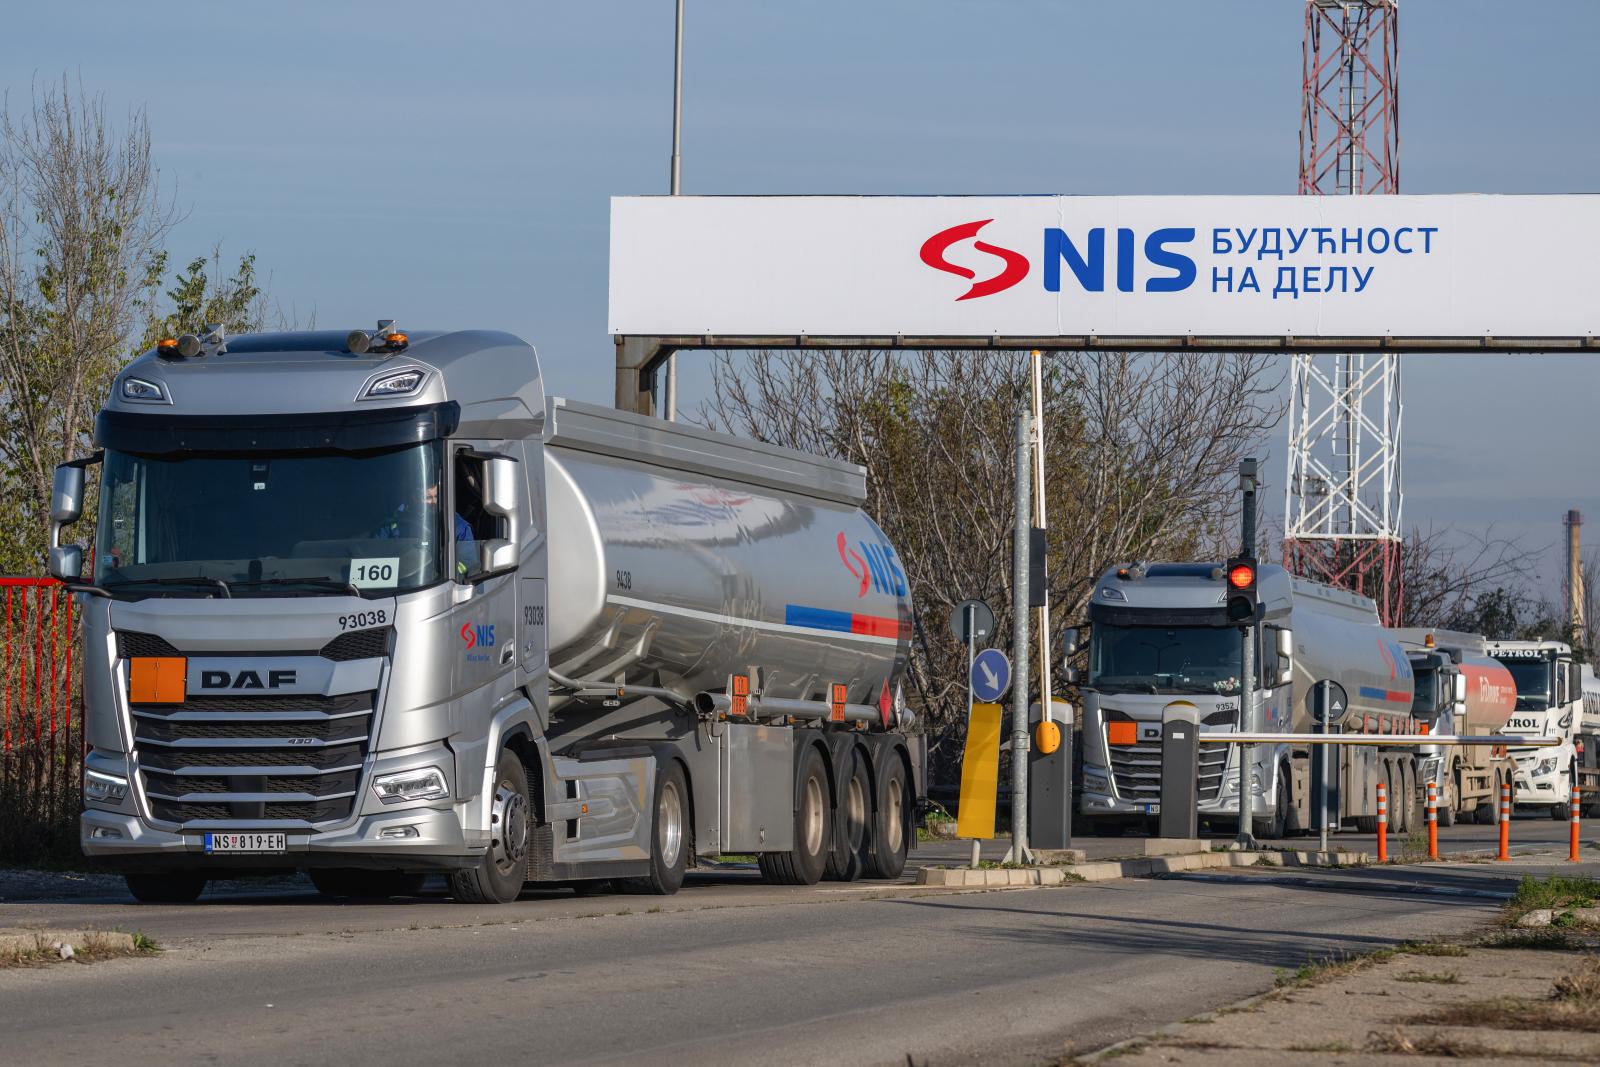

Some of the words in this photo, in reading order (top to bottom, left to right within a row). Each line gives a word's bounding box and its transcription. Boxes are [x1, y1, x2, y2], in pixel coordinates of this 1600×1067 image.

[1212, 227, 1438, 260] БУДУЋНОСТ
[1043, 227, 1197, 293] NIS
[1212, 266, 1261, 292] НА
[1272, 266, 1375, 299] ДЕЛУ
[357, 564, 392, 581] 160
[859, 540, 906, 597] NIS
[338, 610, 387, 630] 93038
[524, 606, 544, 626] 93038
[477, 624, 495, 647] NIS
[1490, 649, 1542, 658] PETROL
[201, 670, 297, 689] DAF
[1506, 718, 1540, 728] TROL
[214, 835, 230, 849] NS
